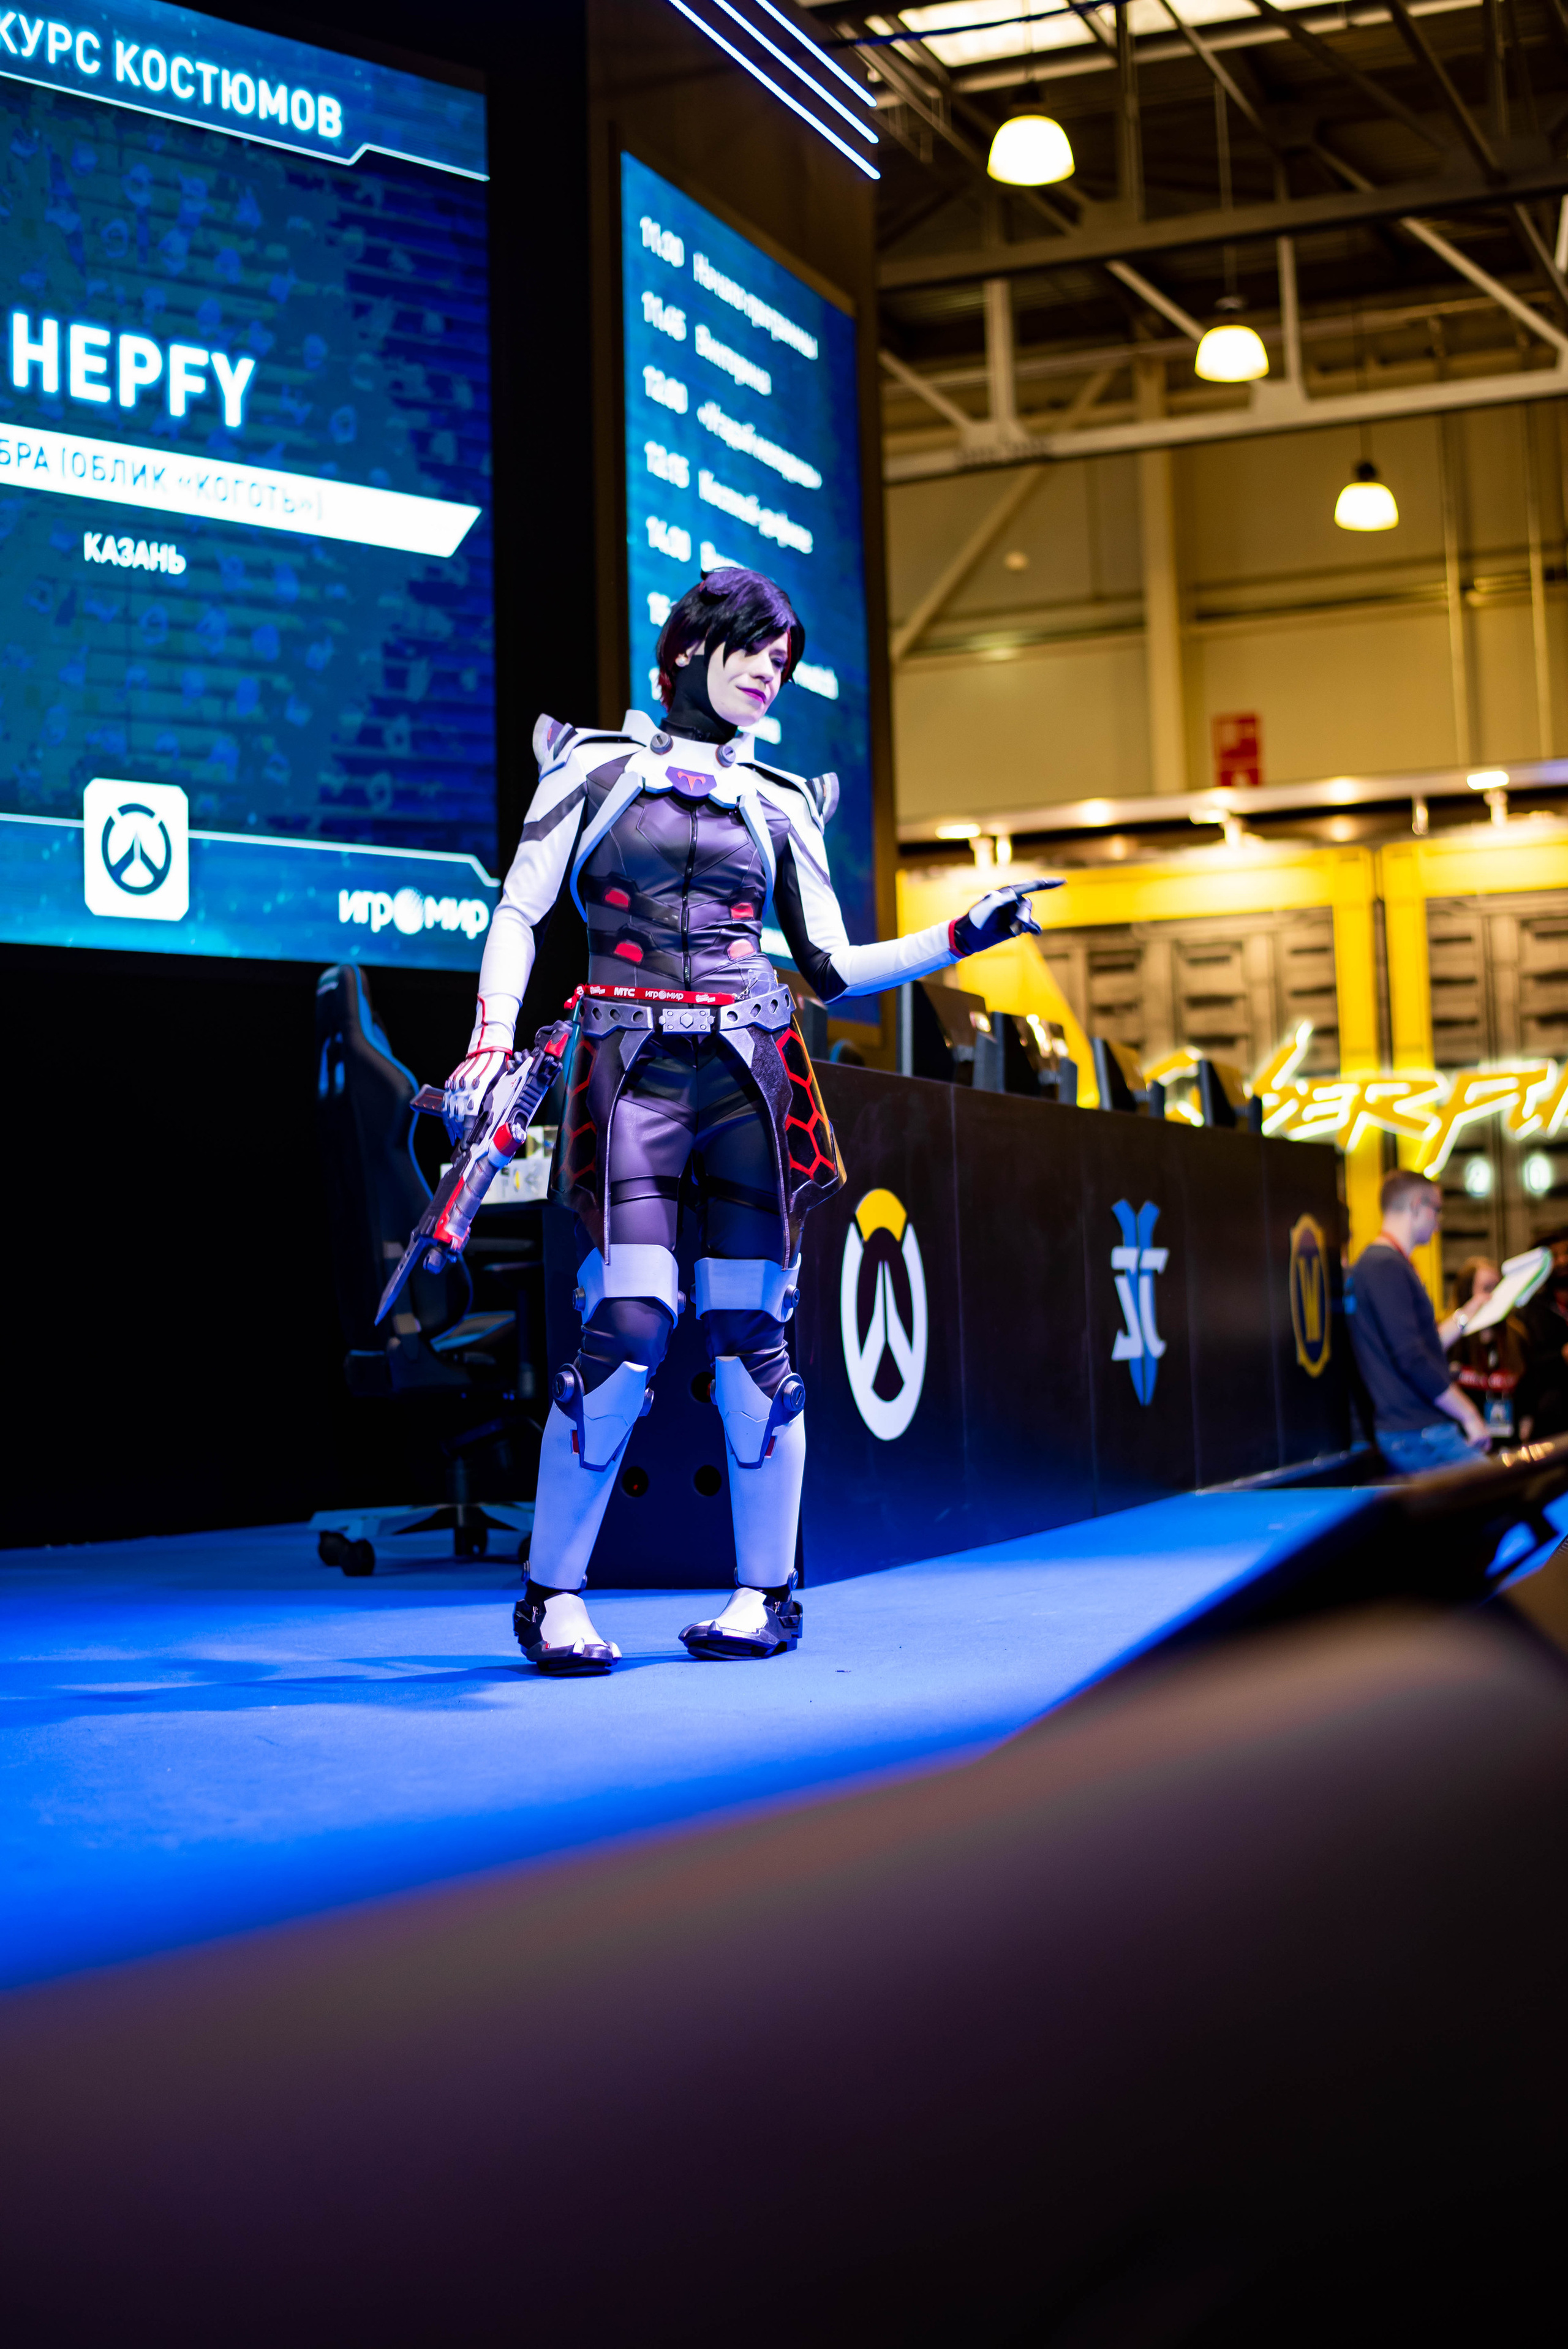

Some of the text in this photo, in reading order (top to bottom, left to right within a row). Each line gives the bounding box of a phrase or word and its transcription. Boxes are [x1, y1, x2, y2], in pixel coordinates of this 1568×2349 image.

[115, 40, 343, 138] КОСТЮМОВ
[12, 312, 255, 427] HEPFY
[84, 531, 186, 575] КАЗАНЬ
